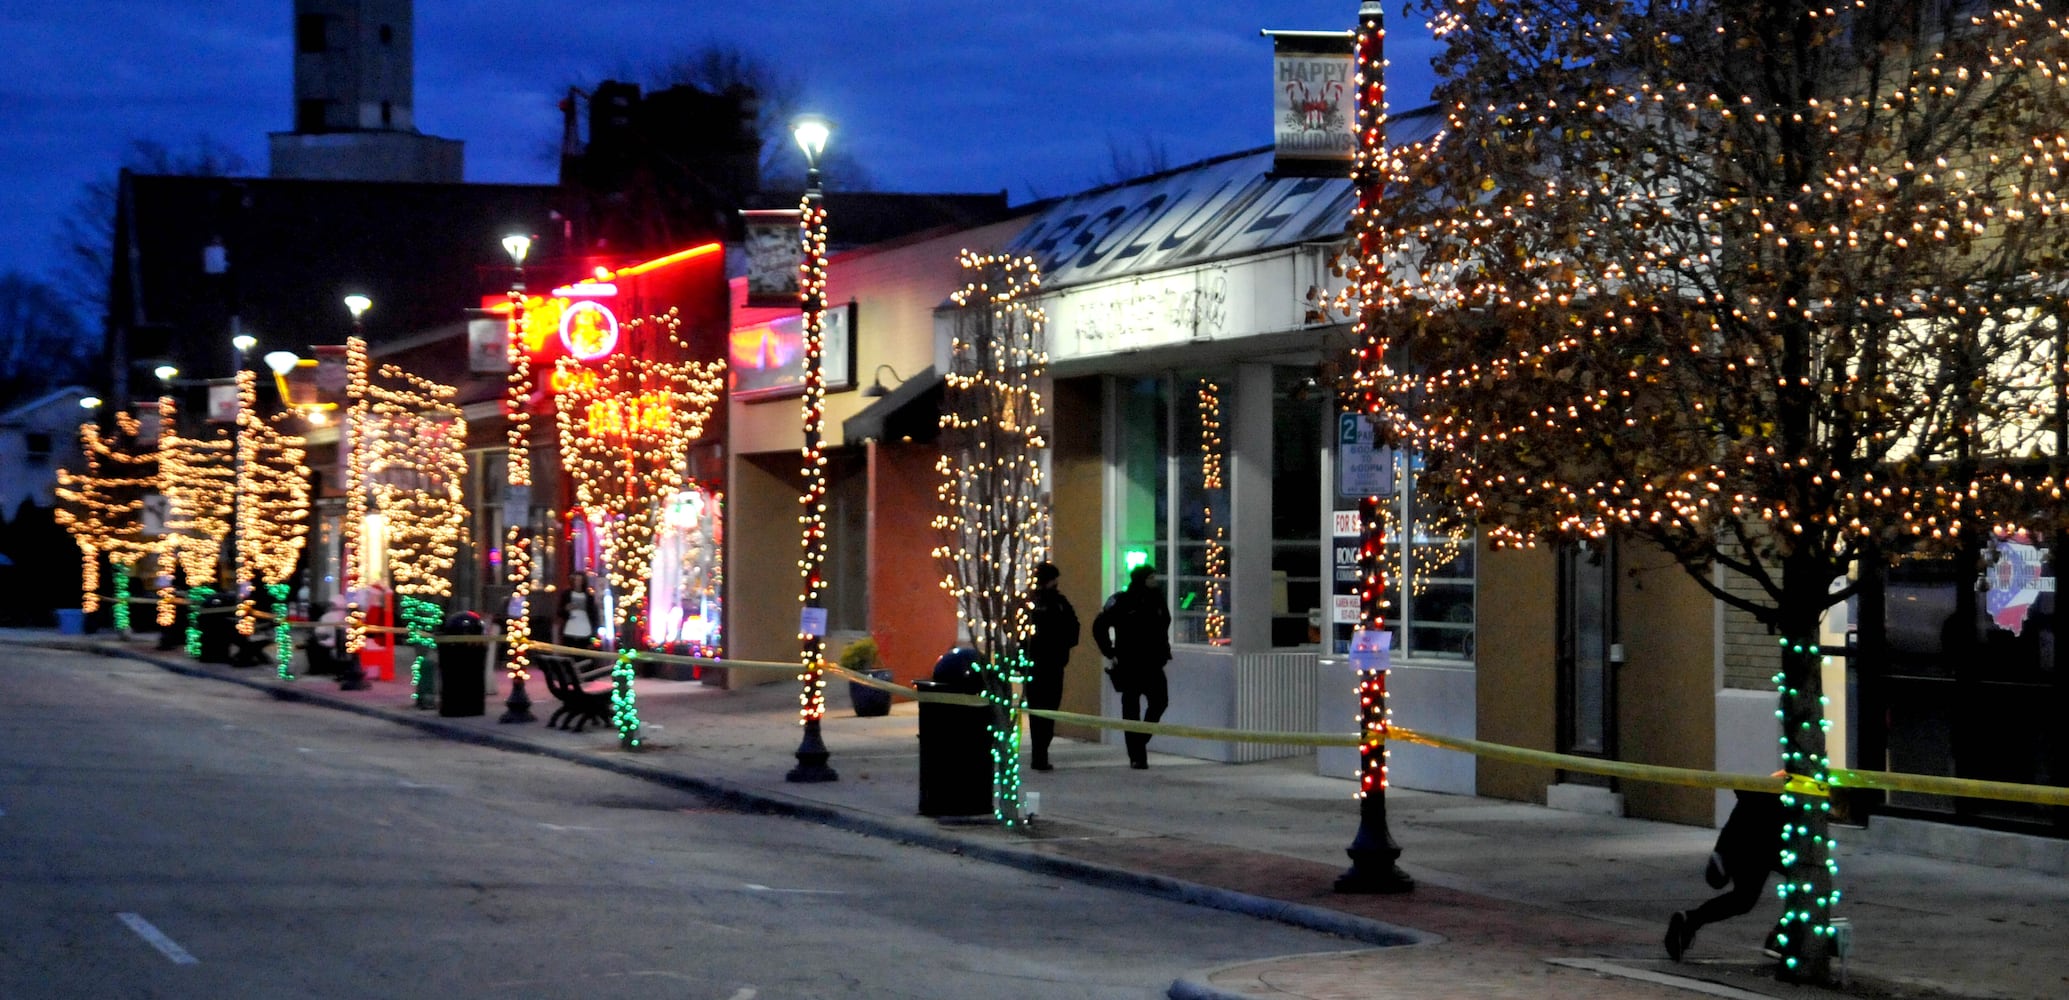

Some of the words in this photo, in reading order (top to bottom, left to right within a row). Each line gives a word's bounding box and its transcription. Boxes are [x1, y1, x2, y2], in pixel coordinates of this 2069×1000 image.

[1280, 61, 1348, 82] HAPPY
[1280, 132, 1354, 152] HOLIDAYS
[1343, 419, 1355, 440] 2
[1336, 514, 1349, 532] FOR
